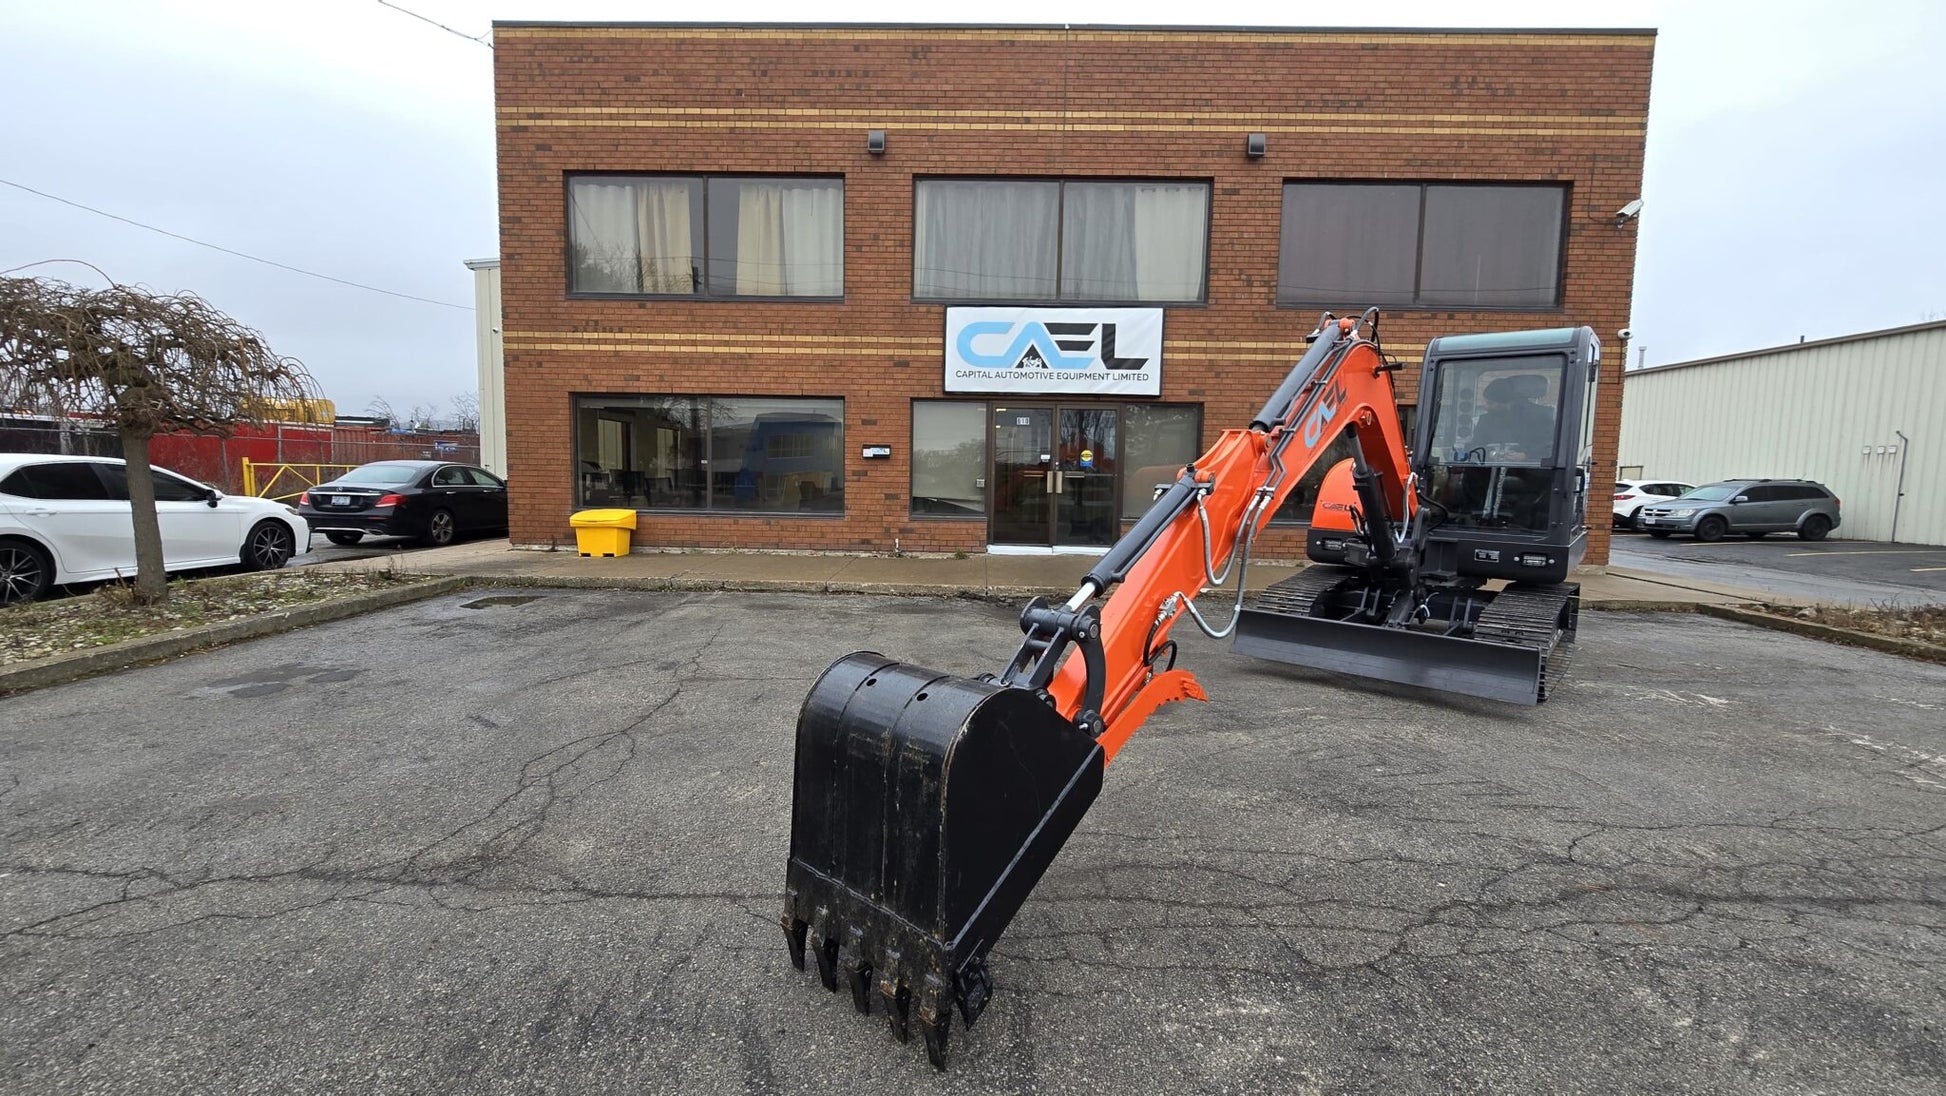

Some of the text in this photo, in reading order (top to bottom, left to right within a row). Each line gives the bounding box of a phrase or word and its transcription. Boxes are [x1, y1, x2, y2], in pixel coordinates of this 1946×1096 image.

[956, 321, 1149, 370] CAEL
[955, 370, 1149, 381] CAPITAL AUTOMOTIVE EQUIPMENT LIMITED
[1304, 380, 1347, 448] CAEL
